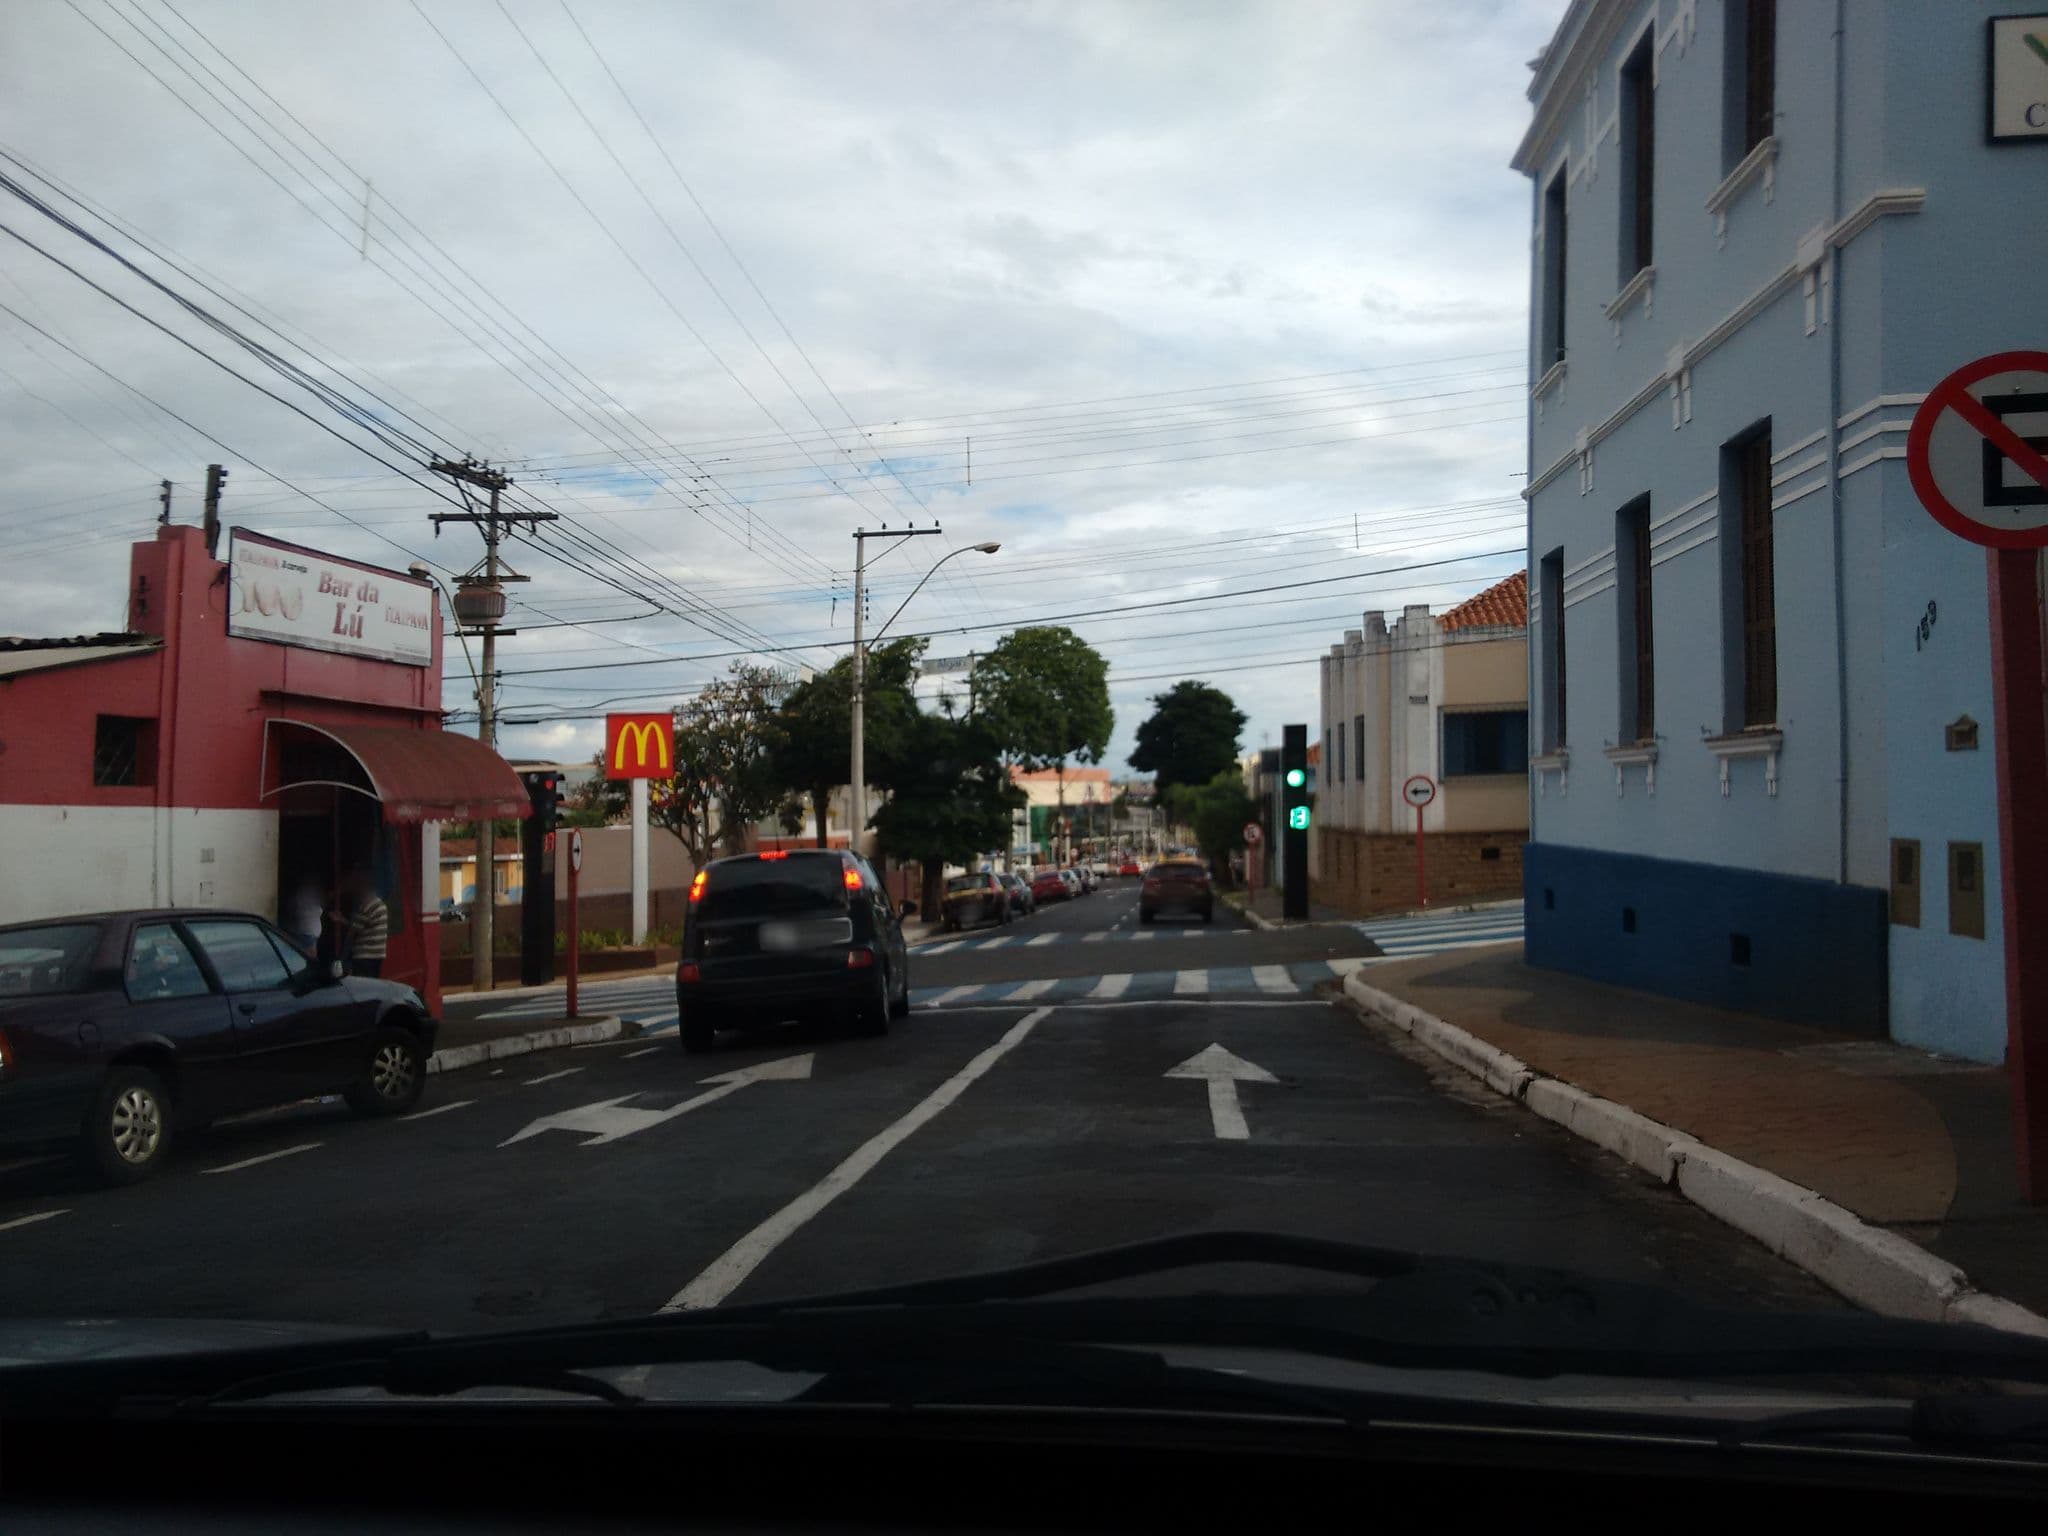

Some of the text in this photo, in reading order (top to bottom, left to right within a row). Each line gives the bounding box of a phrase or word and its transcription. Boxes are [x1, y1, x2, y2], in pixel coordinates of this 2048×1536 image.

[318, 571, 378, 604] Bar da
[332, 602, 363, 639] Lú
